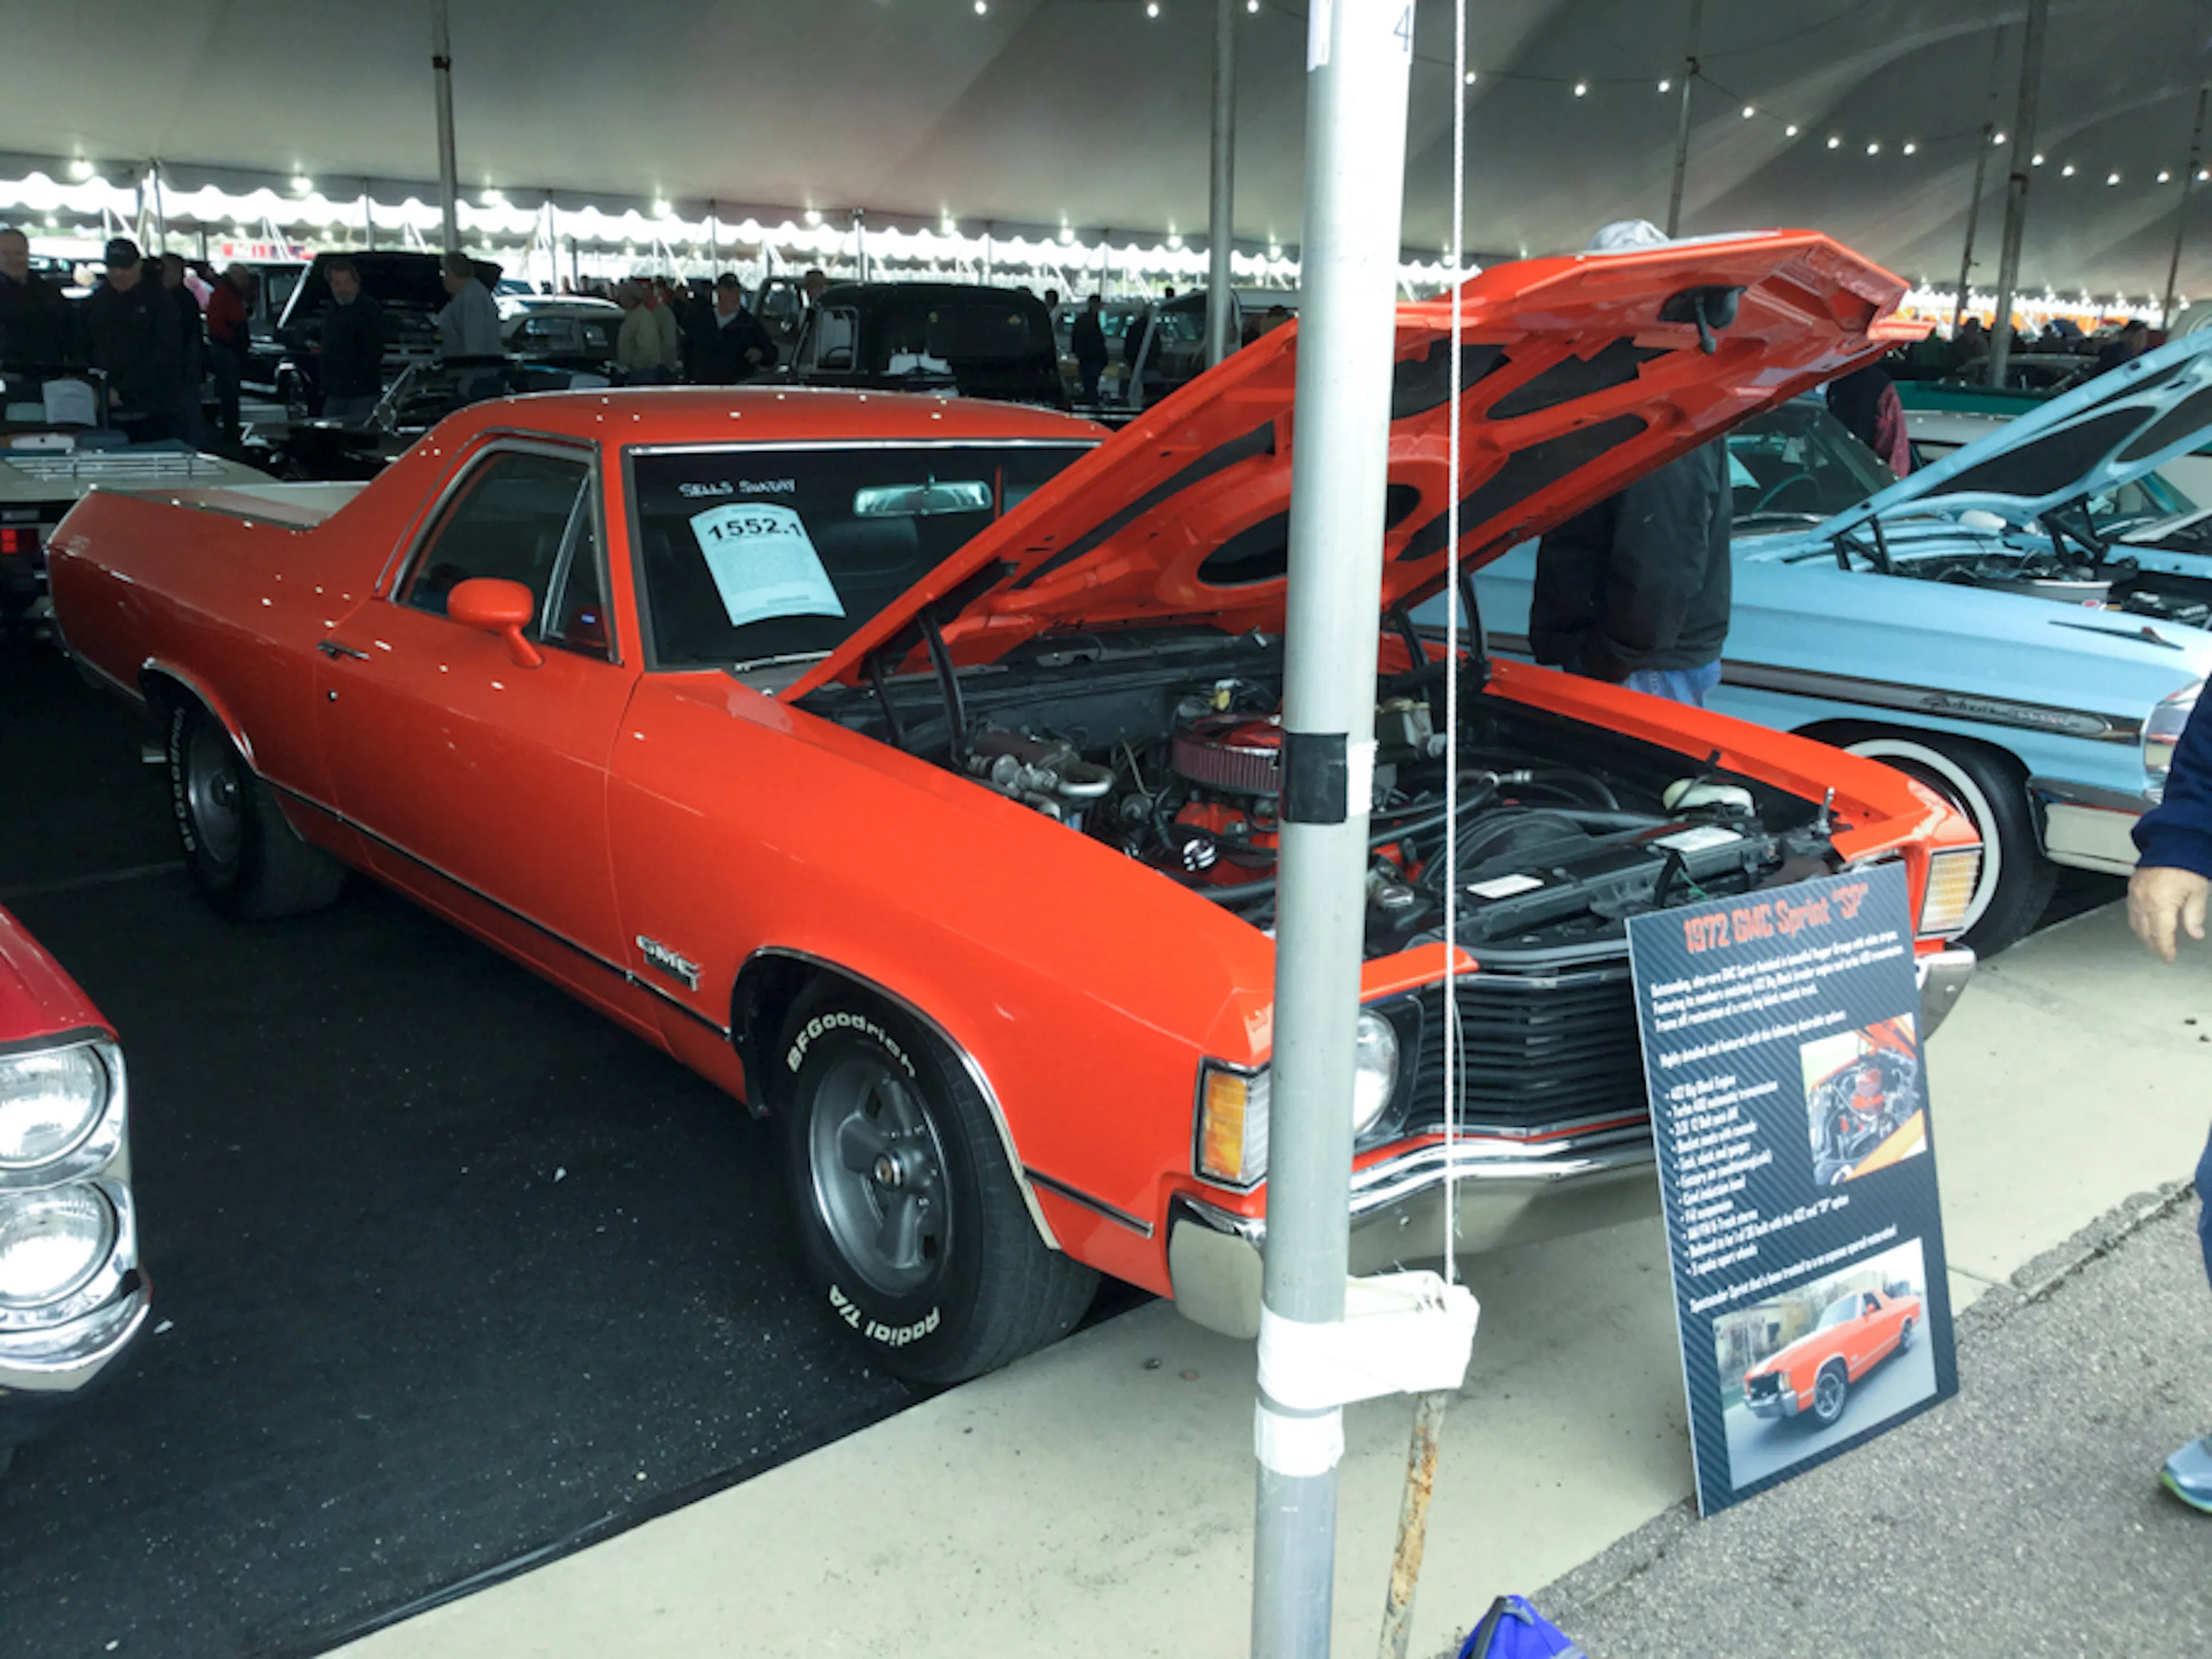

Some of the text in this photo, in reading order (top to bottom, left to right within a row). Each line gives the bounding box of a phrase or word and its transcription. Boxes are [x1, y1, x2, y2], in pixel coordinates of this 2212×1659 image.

[708, 517, 802, 540] 1552.1
[1683, 912, 1730, 955] 1972
[1731, 903, 1774, 943] GMC
[1775, 899, 1831, 937] Sprint
[787, 1011, 916, 1078] BFGoodrich
[828, 1283, 941, 1348] Radial T/A
